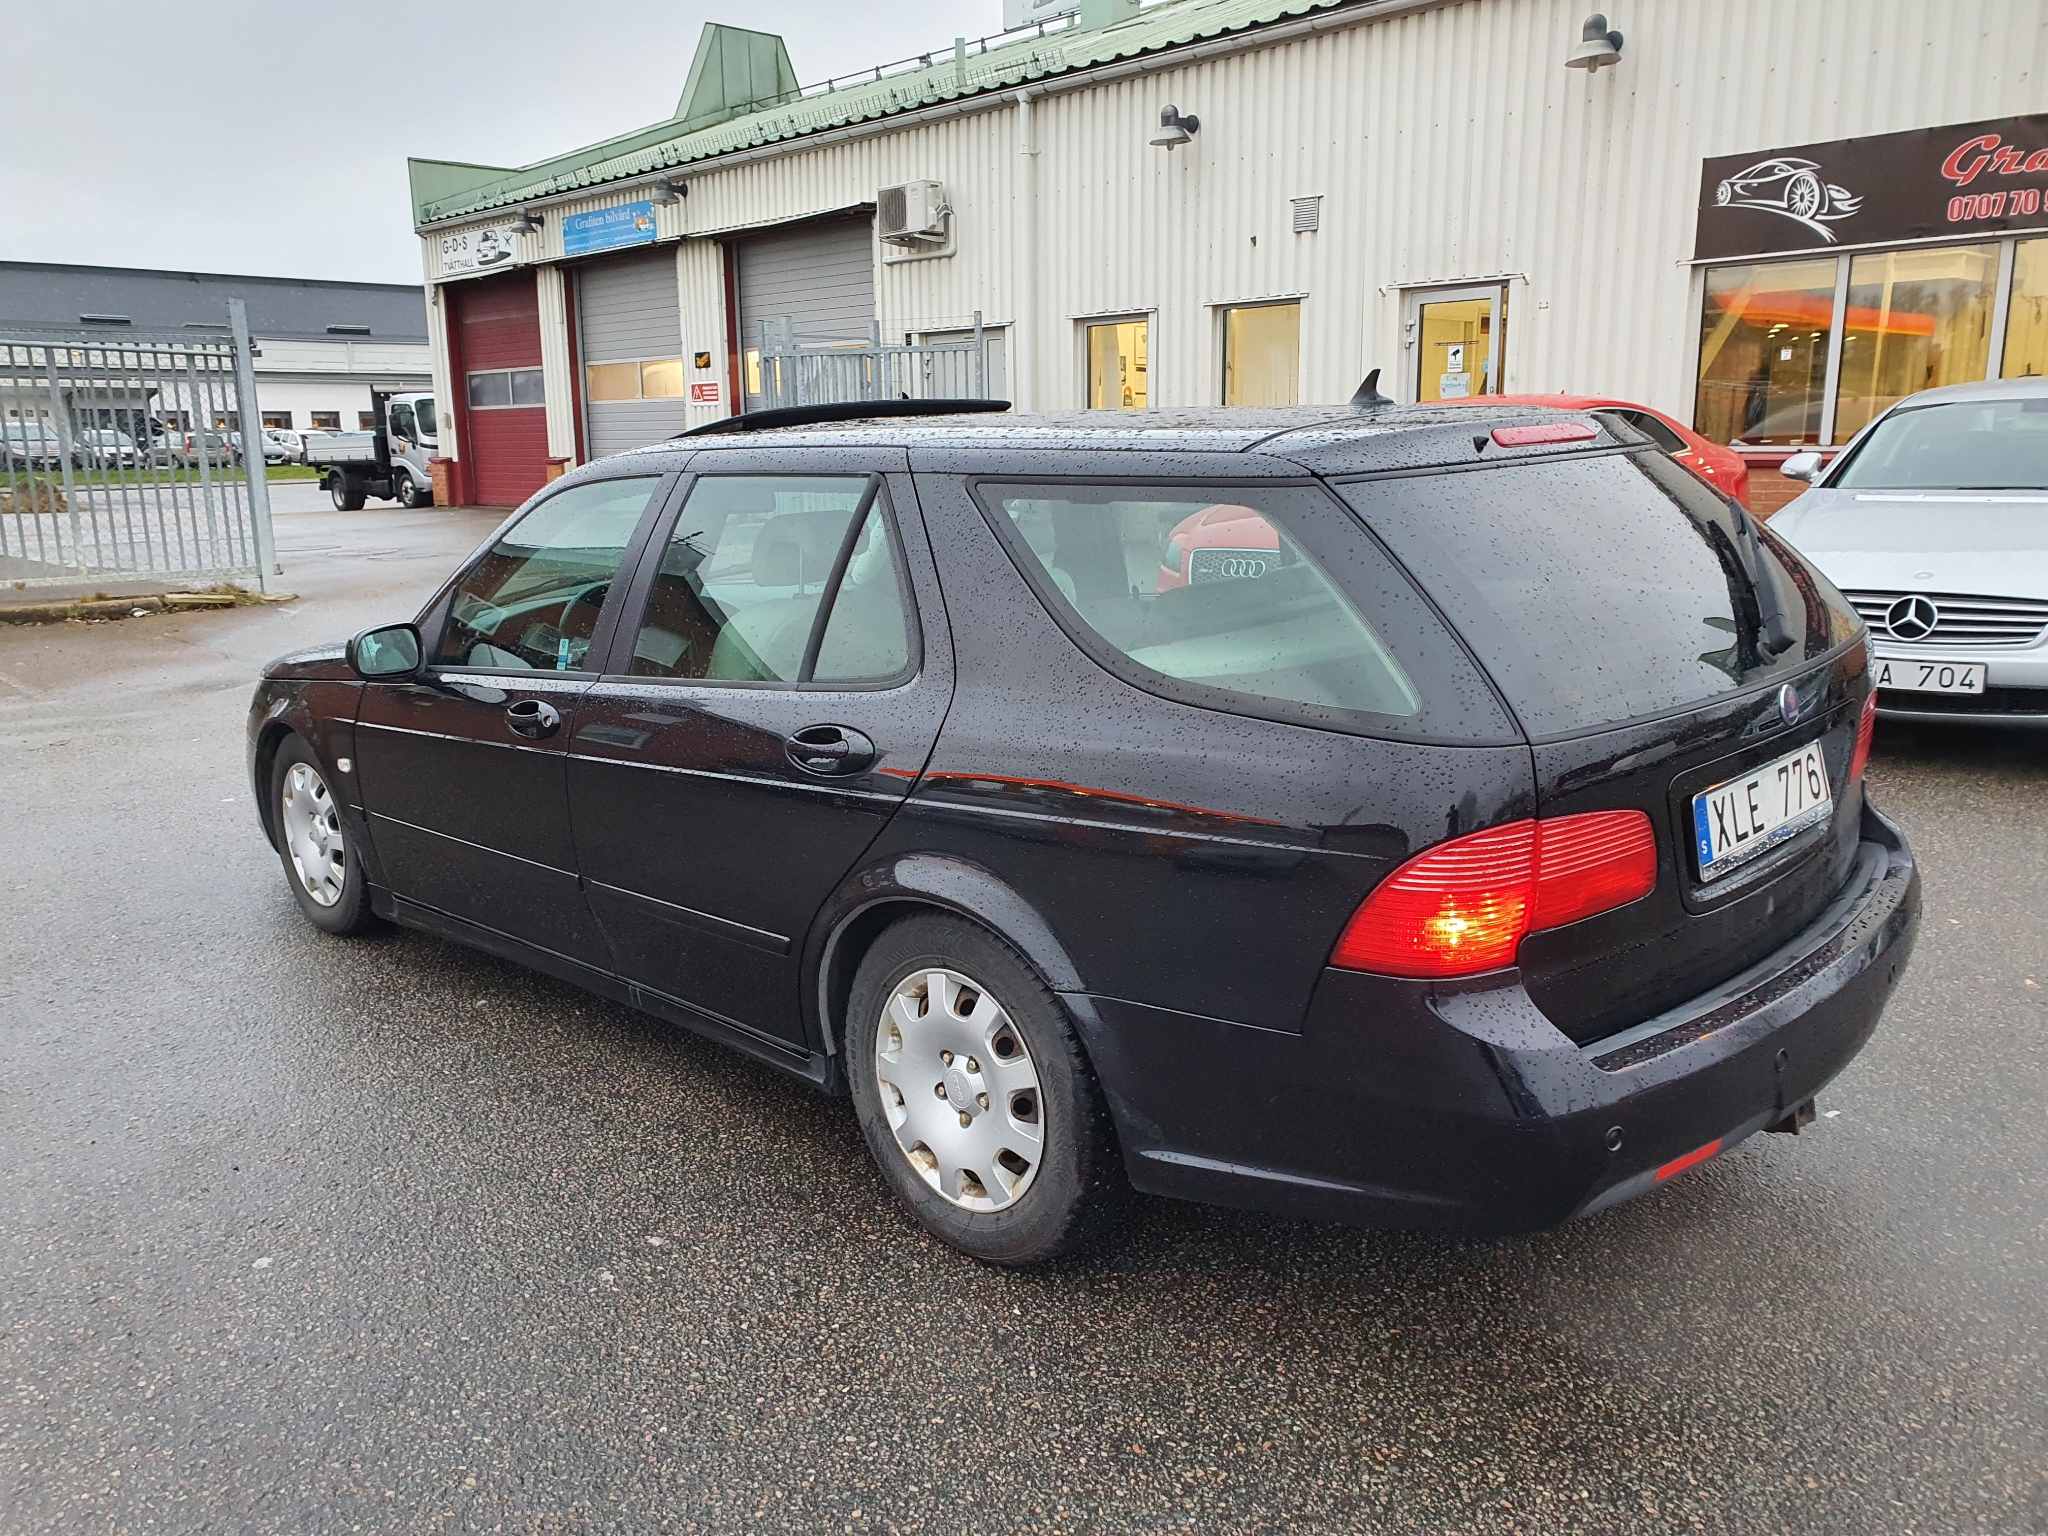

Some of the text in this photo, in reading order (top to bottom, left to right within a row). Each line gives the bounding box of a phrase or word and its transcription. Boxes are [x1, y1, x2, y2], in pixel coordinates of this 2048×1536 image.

[1947, 191, 2008, 222] 0707
[2009, 188, 2040, 216] 70
[574, 207, 631, 230] Grafiten bilvård
[1917, 665, 1976, 690] 704
[1712, 752, 1821, 853] XLE 776
[1701, 839, 1708, 855] S
